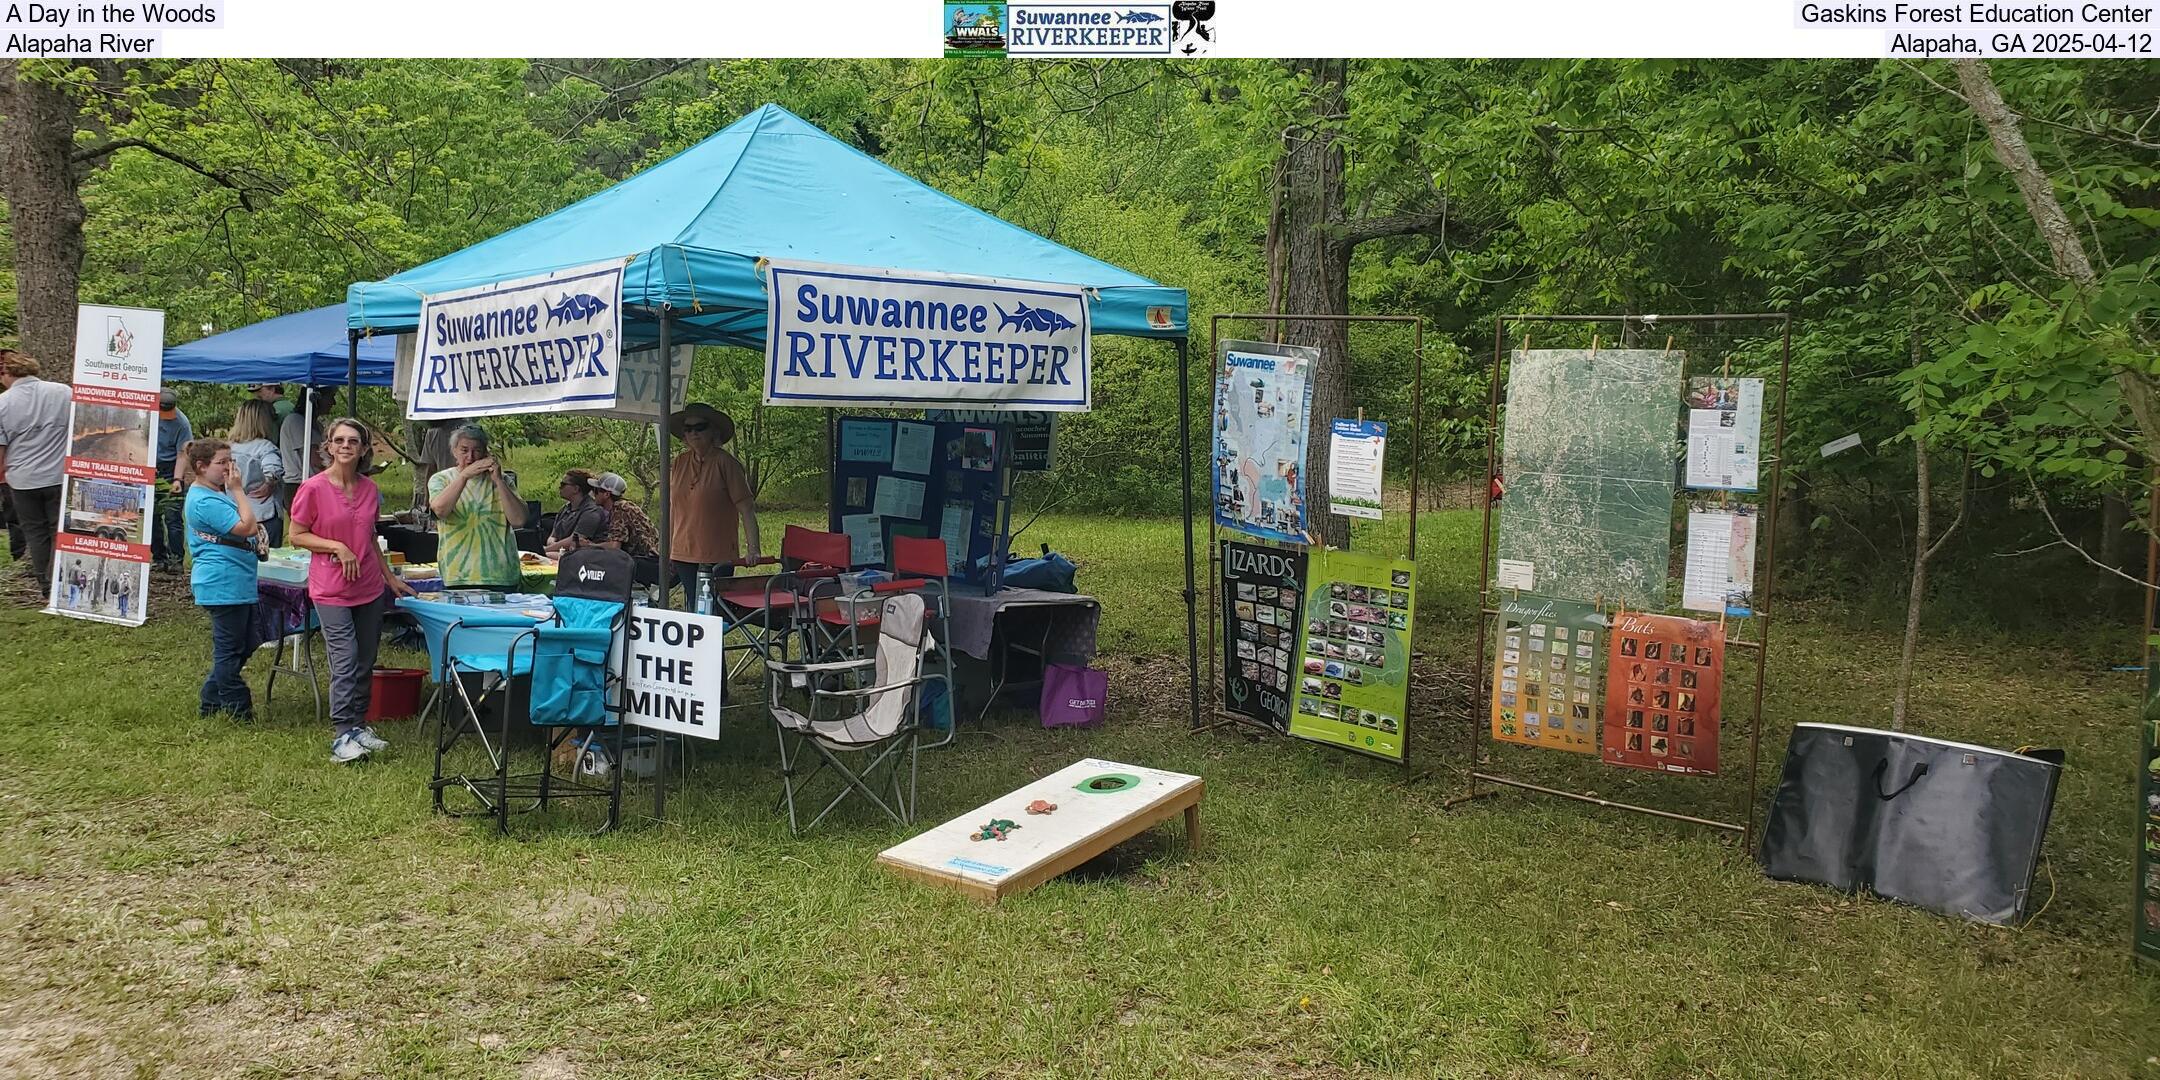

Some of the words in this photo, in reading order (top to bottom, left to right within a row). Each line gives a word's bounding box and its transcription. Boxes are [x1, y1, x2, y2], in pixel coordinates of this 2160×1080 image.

[797, 284, 987, 333] Suwannee
[436, 302, 539, 347] Suwannee
[85, 358, 121, 371] Southwest
[123, 362, 148, 375] Georgia
[1226, 352, 1276, 371] Suwannee
[102, 371, 128, 381] PBA
[74, 386, 116, 398] LANDOWNER
[117, 391, 156, 402] ASSISTANCE
[953, 410, 1046, 424] WWALS
[71, 460, 90, 469] BURN
[91, 462, 118, 473] TRAILER
[119, 466, 144, 476] RENTAL
[75, 537, 99, 548] LEARN
[99, 540, 109, 549] TO
[109, 542, 129, 552] BURN
[1223, 543, 1295, 579] LIZARDS
[1505, 600, 1558, 626] Dragonflies
[628, 616, 705, 649] STOP
[1620, 616, 1656, 635] Bats
[636, 653, 694, 686] THE
[626, 689, 705, 726] MINE
